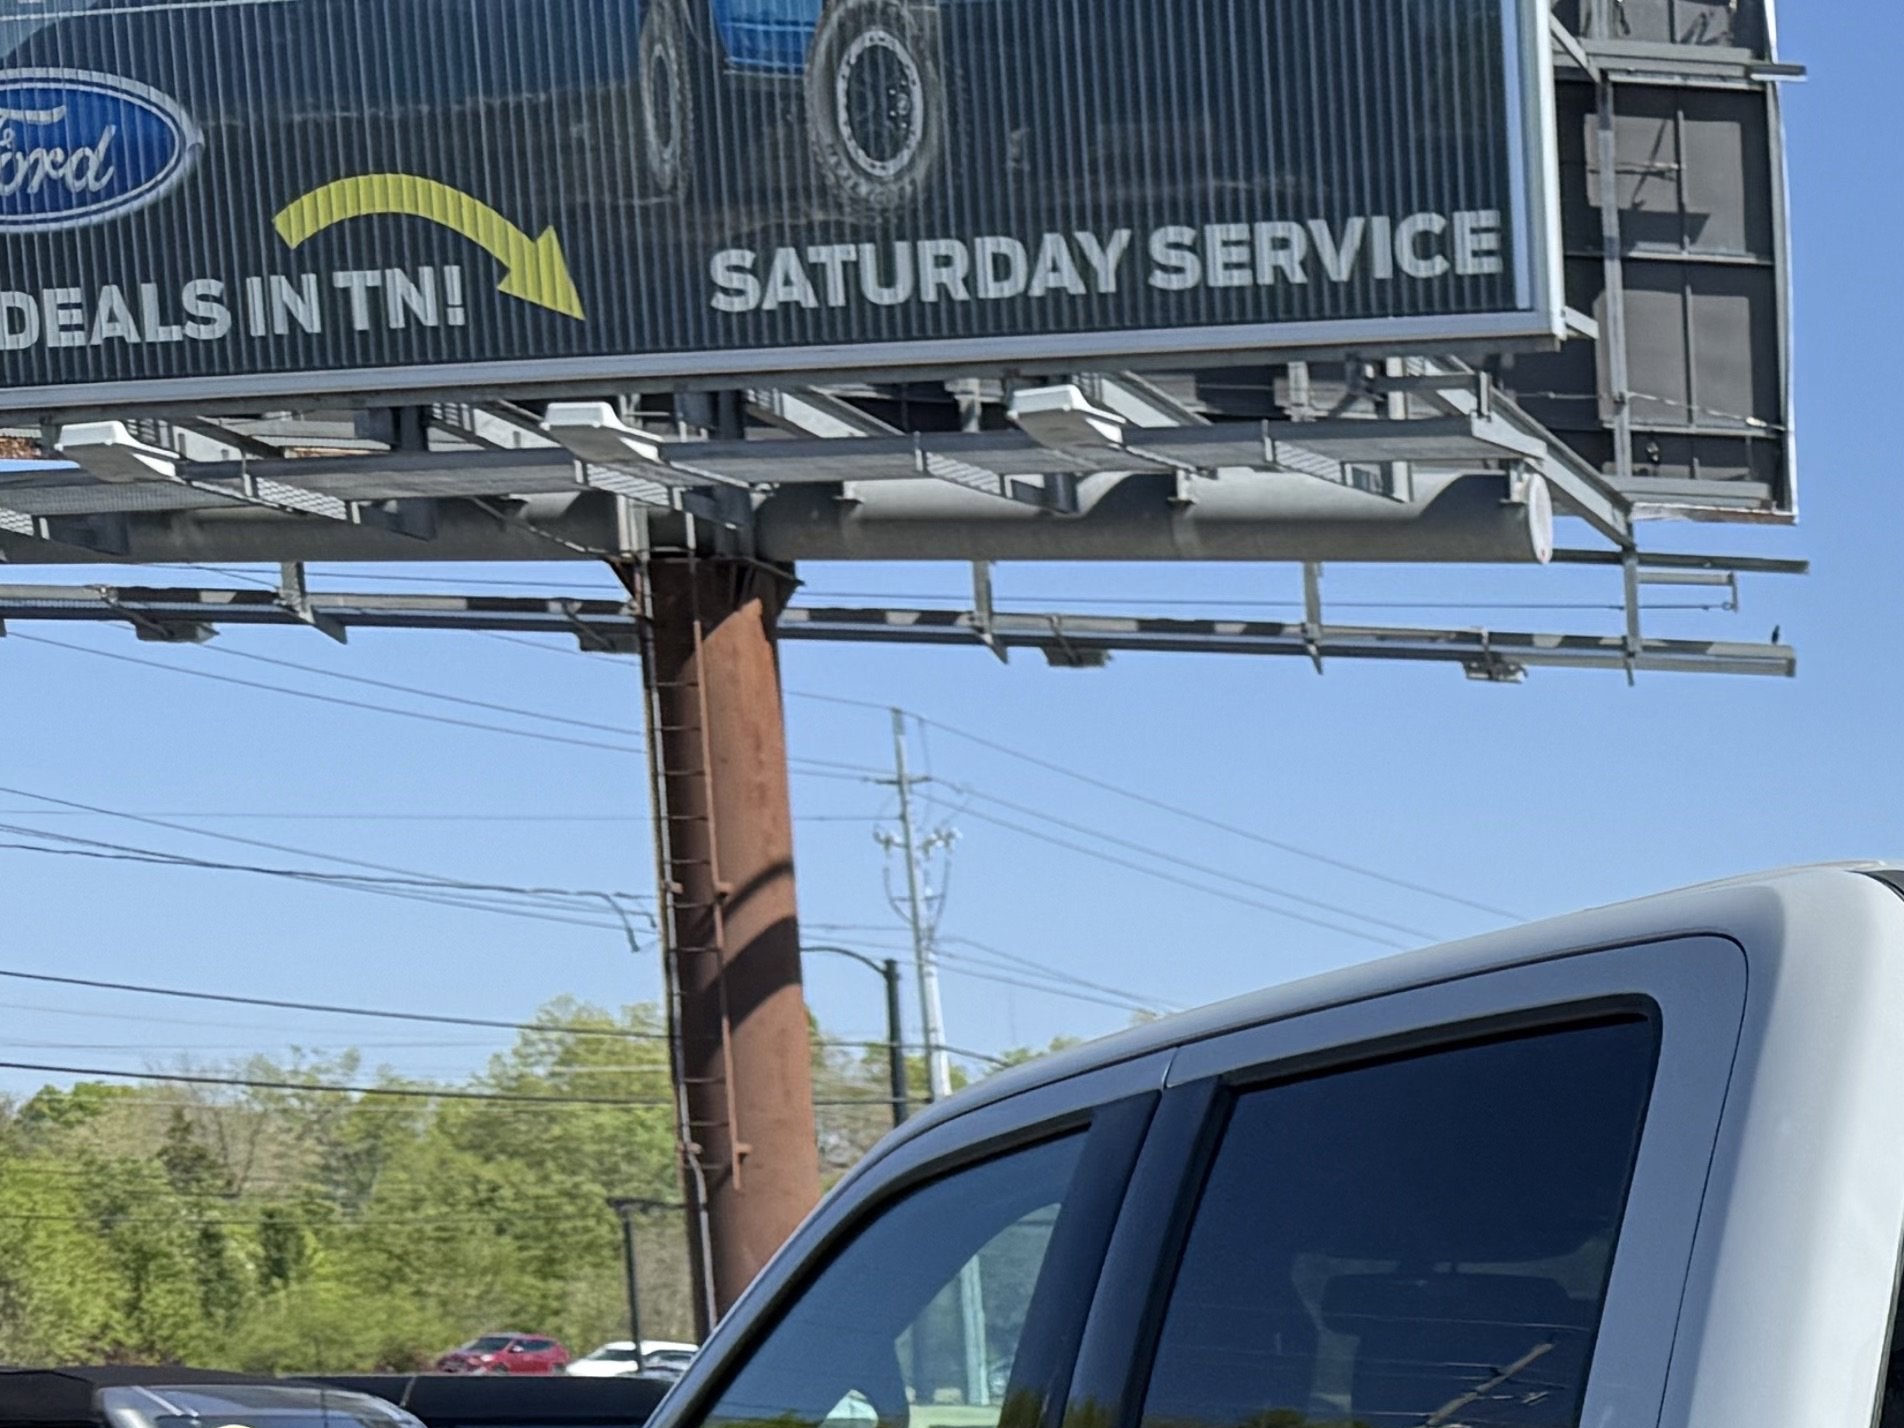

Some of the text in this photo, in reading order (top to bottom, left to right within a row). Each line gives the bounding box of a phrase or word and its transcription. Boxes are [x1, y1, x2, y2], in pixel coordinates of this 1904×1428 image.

[0, 264, 466, 351] DEALS IN TN!
[709, 210, 1503, 313] SATURDAY SERVICE
